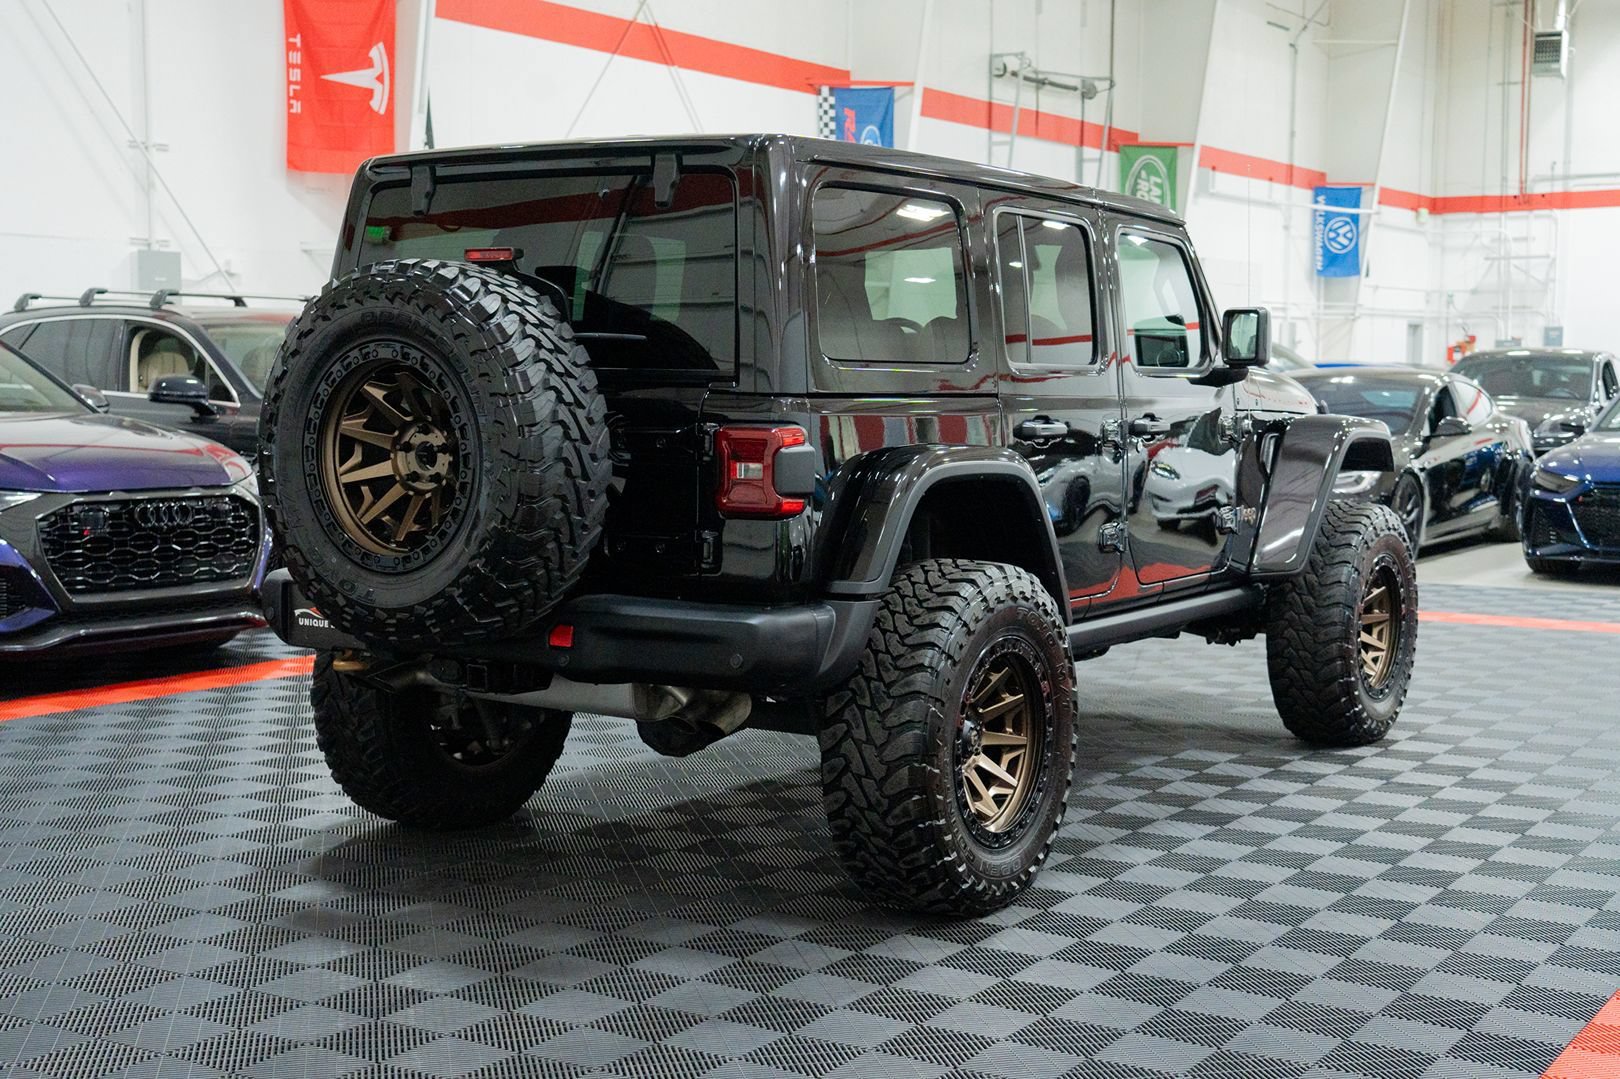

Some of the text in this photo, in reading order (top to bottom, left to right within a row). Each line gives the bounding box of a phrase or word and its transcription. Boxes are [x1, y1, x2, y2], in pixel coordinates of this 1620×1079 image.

[288, 33, 302, 114] TESLA
[1314, 194, 1327, 271] VLKSWAGEN
[298, 617, 329, 628] UNIQUE
